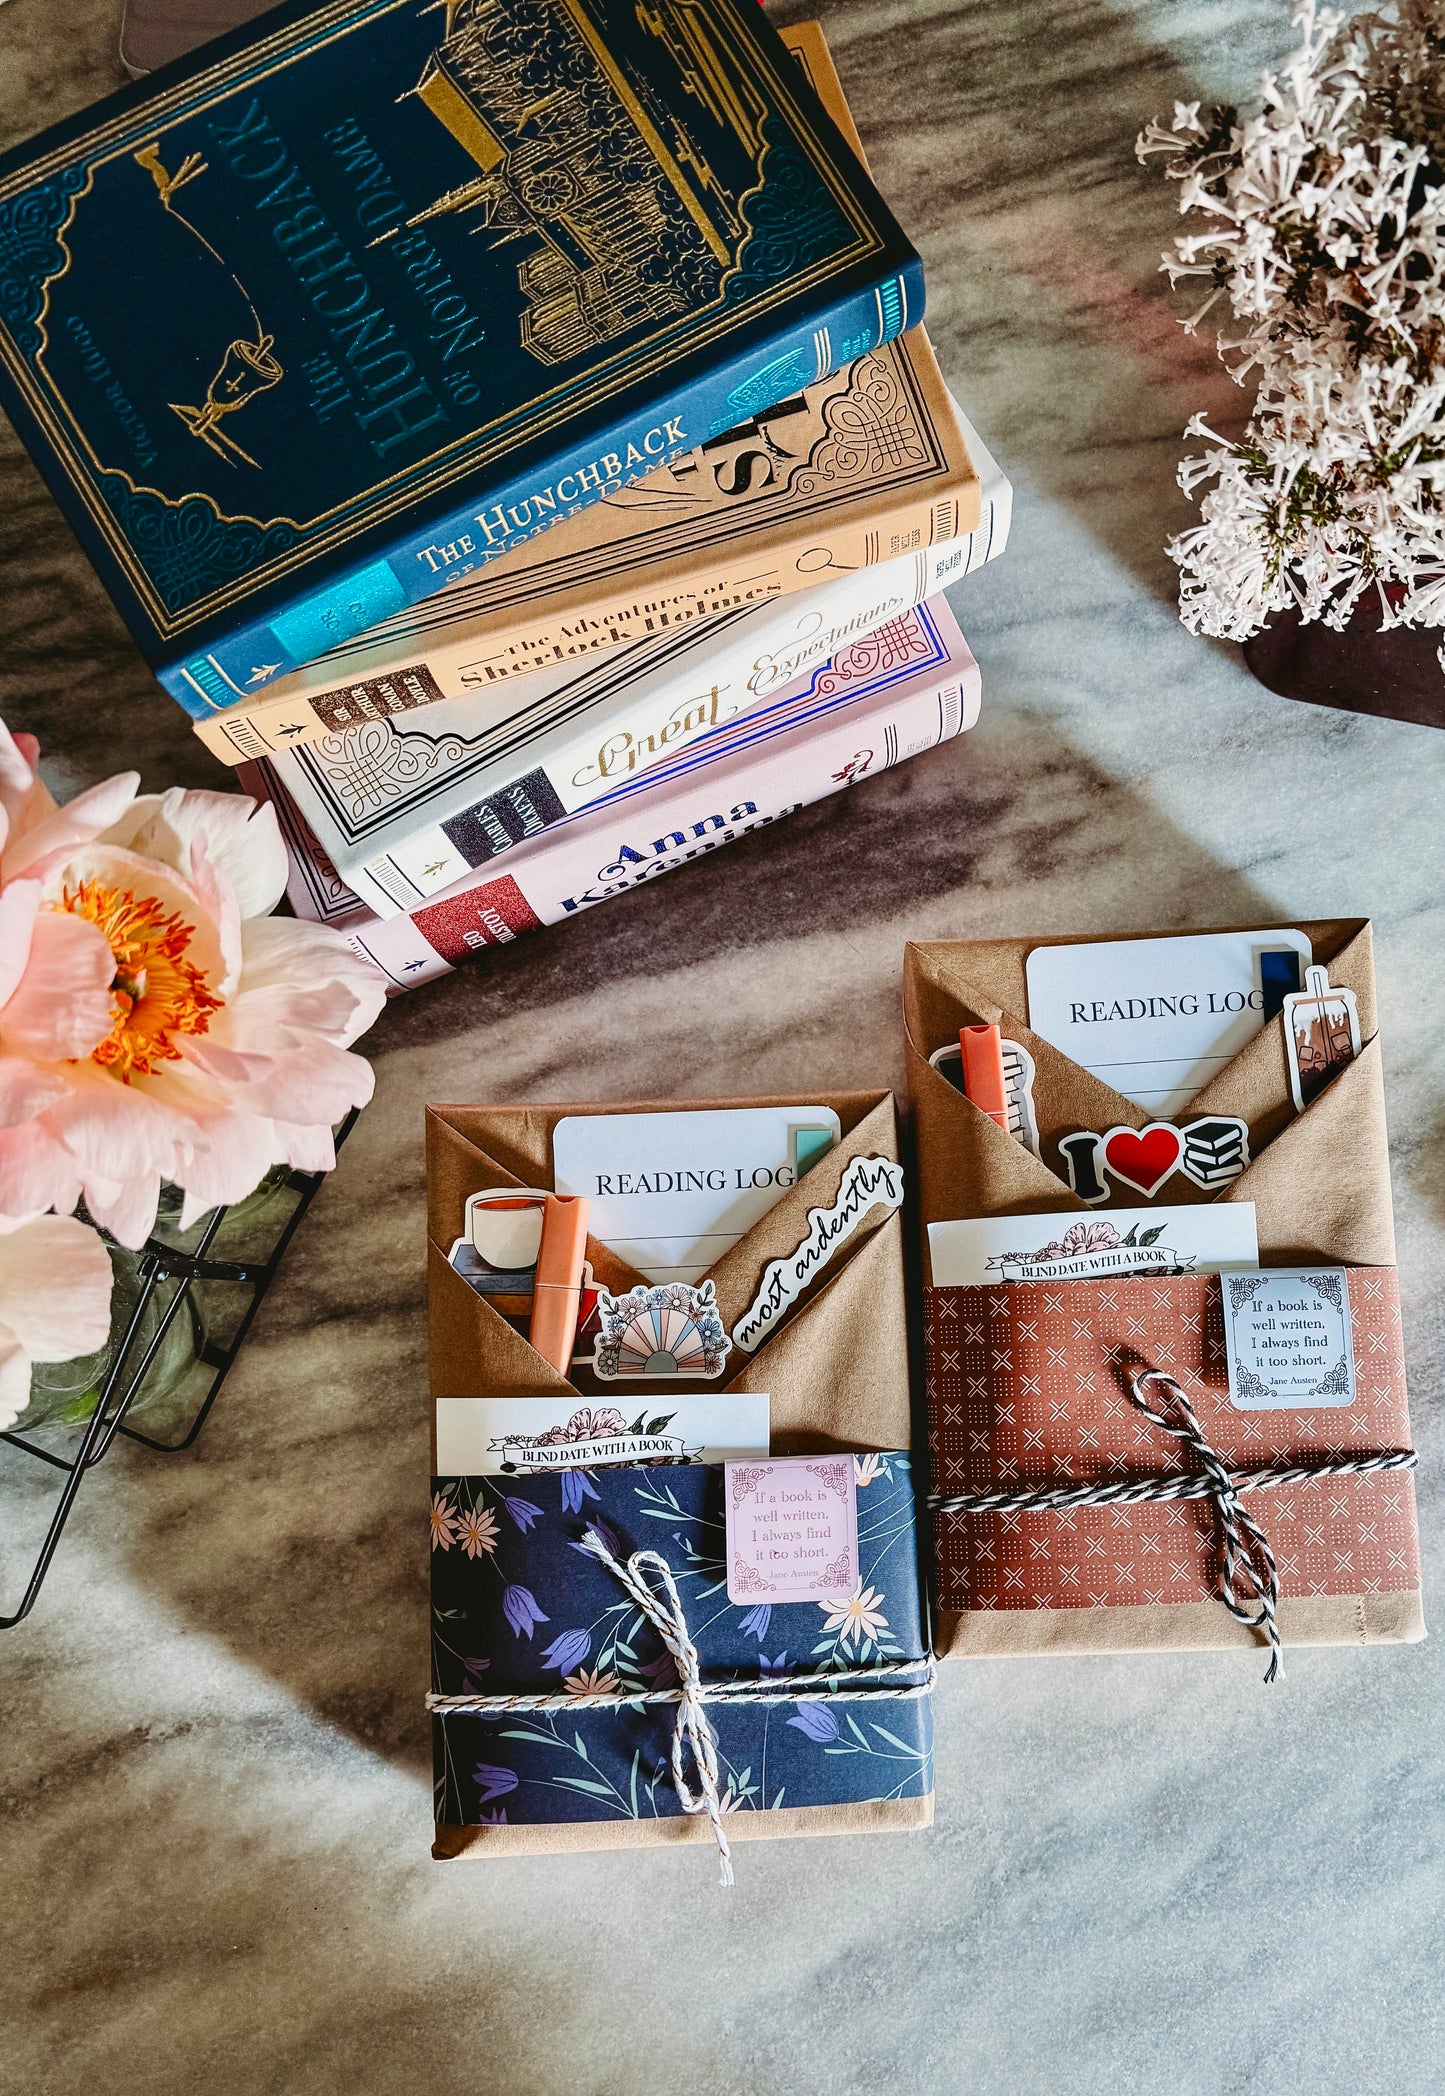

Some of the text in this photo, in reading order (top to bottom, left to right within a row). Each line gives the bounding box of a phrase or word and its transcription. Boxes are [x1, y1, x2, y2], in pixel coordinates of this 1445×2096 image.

[207, 98, 450, 458] HUNCHBACK
[416, 533, 476, 574] THE
[474, 414, 689, 547] HUNCHBACK
[502, 580, 729, 657] The Adventures of
[460, 582, 783, 689] Sherlock Holmes
[377, 682, 406, 711] CONAN
[572, 596, 904, 787] Great Expectations
[333, 706, 352, 721] SIR
[507, 786, 545, 837] DICKENS
[474, 804, 514, 854] CHARLES
[597, 801, 760, 881] Anna
[462, 930, 487, 950] LEO
[1069, 989, 1264, 1024] READING LOG
[595, 1166, 796, 1196] READING LOG
[740, 1164, 896, 1344] most ardently
[1021, 1251, 1167, 1278] BLIND DATE WITH A BOOK
[1252, 1299, 1323, 1312] If a book is
[1252, 1318, 1325, 1330] well written,
[1251, 1335, 1328, 1350] I always find
[1256, 1354, 1326, 1367] it too short.
[1290, 1376, 1318, 1384] Austen
[522, 1440, 674, 1462] BLIND DATE WITH A BOOK
[755, 1490, 827, 1504] If a book is
[753, 1510, 778, 1522] well
[752, 1526, 831, 1542] I always find
[756, 1547, 829, 1561] it too short.
